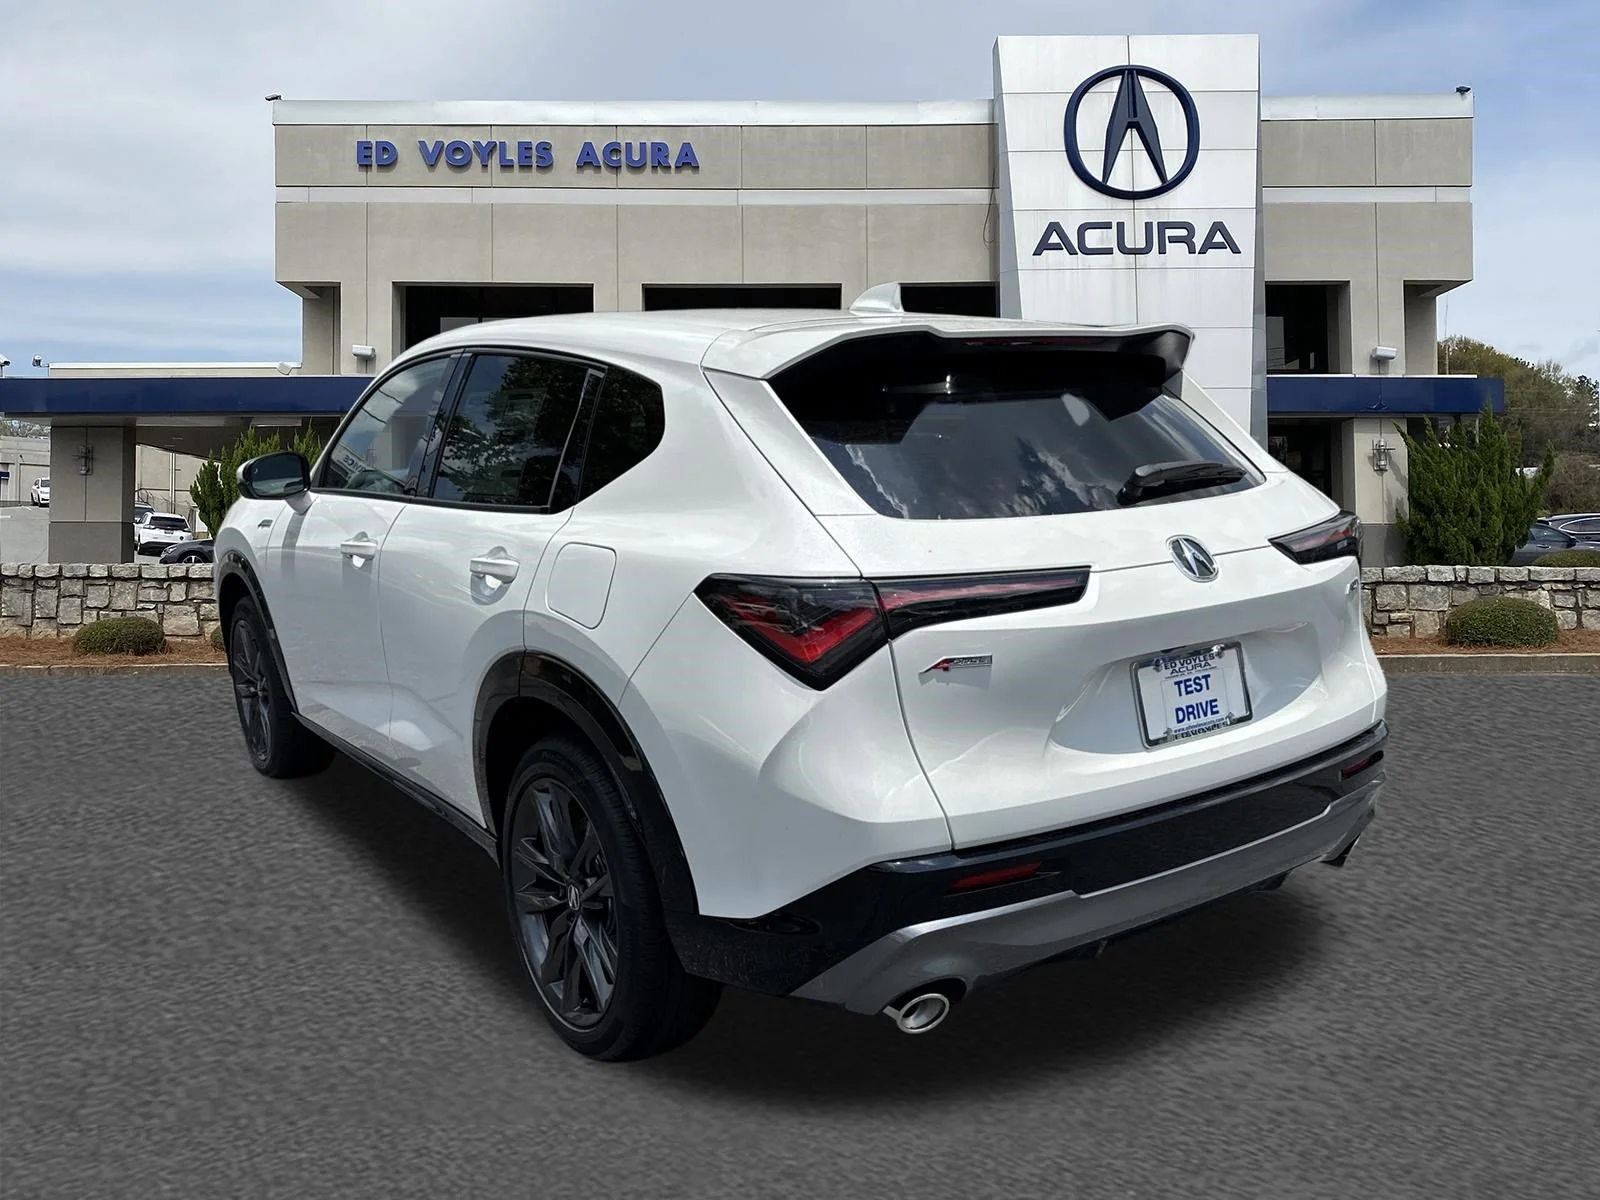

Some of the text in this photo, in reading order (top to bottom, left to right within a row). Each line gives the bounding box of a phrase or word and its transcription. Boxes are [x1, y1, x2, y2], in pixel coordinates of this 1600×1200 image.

[356, 140, 700, 168] ED VOYLES ACURA
[1032, 221, 1242, 256] ACURA
[1163, 653, 1215, 670] ED VOYLES
[1170, 661, 1212, 675] ACURA
[1174, 673, 1211, 697] TEST
[1175, 698, 1220, 724] DRIVE
